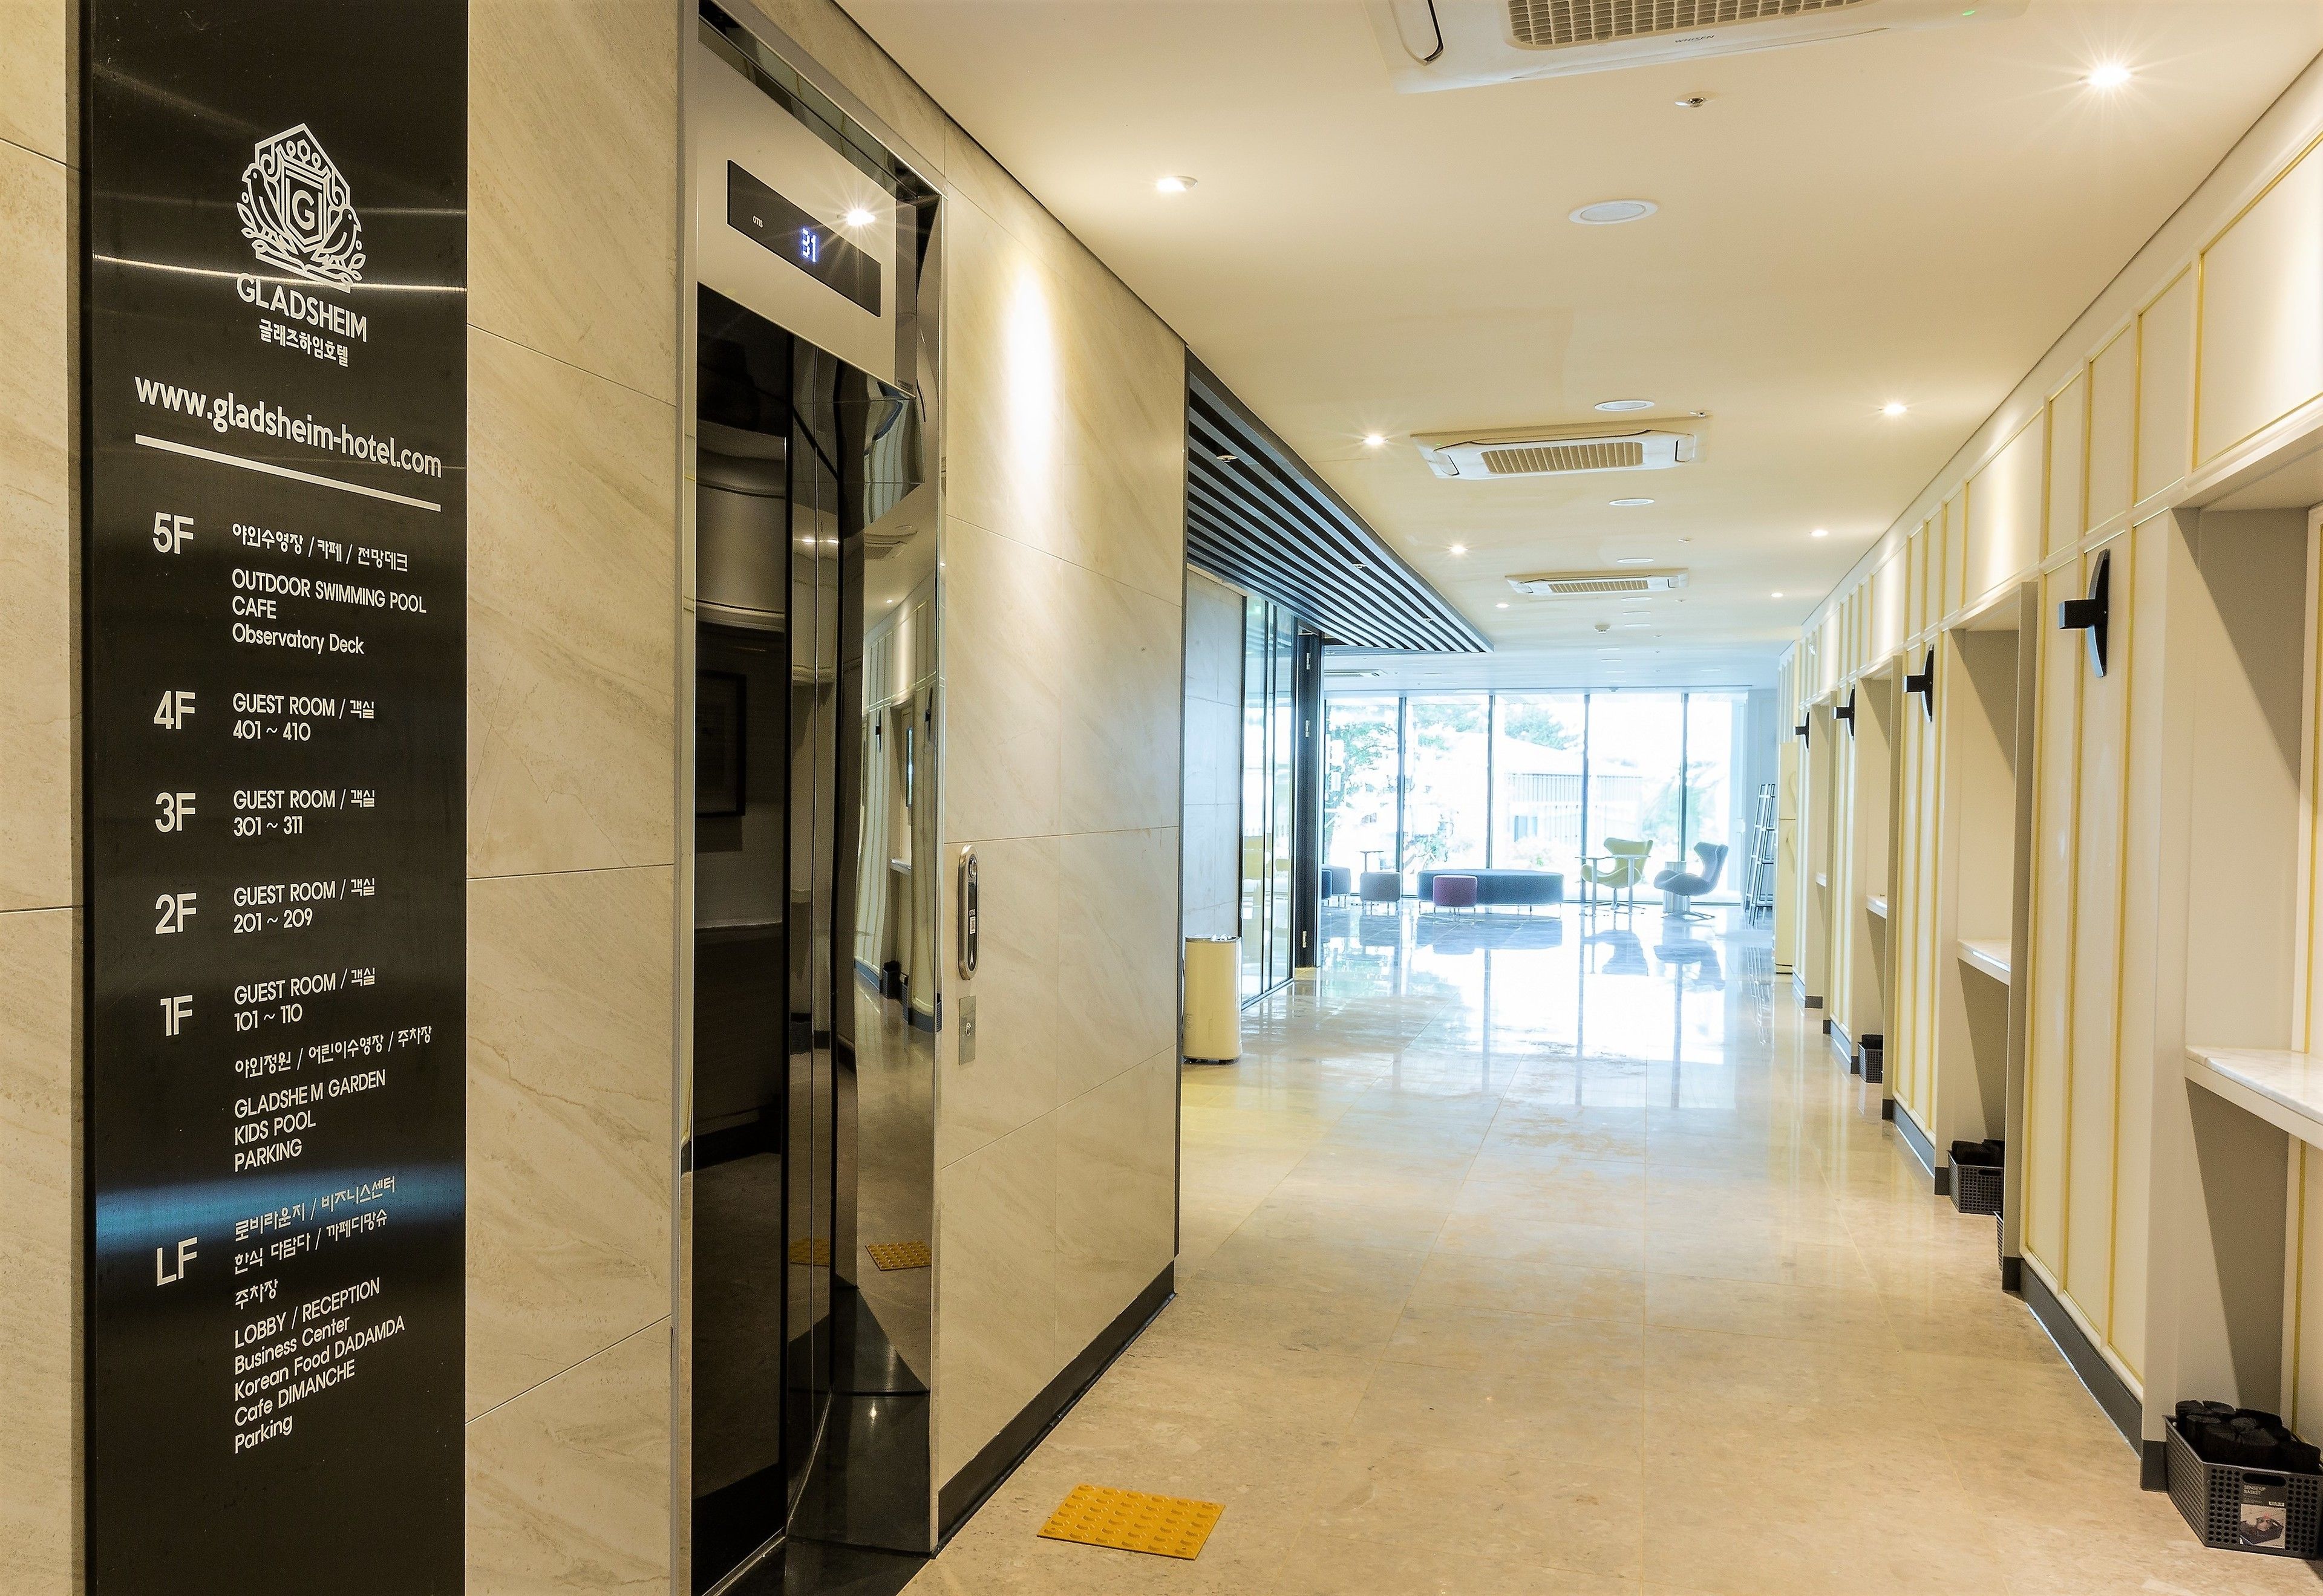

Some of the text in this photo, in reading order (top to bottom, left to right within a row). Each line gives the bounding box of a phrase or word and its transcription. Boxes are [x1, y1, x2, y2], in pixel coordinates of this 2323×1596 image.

[291, 190, 316, 232] G
[753, 215, 763, 228] OTIS
[237, 272, 367, 343] GLADSHEIM
[259, 318, 348, 368] 글래즈하임호텔
[134, 376, 442, 478] www.gladsheim-hotel.com
[152, 511, 194, 555] 5F
[232, 523, 304, 555] 야외수영장
[317, 539, 342, 562] 카페
[358, 547, 408, 572] 전망데크
[232, 568, 427, 614] OUTDOOR SWIMMING POOL
[232, 595, 276, 619] CAFE
[232, 622, 365, 655] Observatory Deck
[154, 690, 195, 729] 4F
[232, 692, 284, 714] GUEST
[289, 696, 335, 717] ROOM
[350, 700, 374, 719] 객실
[233, 720, 261, 740] 401
[283, 721, 311, 741] 410
[155, 792, 196, 833] 3F
[233, 789, 285, 810] GUEST
[290, 789, 336, 809] ROOM
[350, 789, 375, 808] 객실
[233, 816, 261, 837] 301
[283, 815, 302, 835] 311
[234, 884, 286, 907] GUEST
[290, 881, 336, 902] ROOM
[350, 878, 375, 897] 객실
[155, 893, 197, 934] 2F
[234, 912, 262, 934] 201
[283, 907, 313, 928] 209
[234, 980, 286, 1005] GUEST
[290, 972, 336, 997] ROOM
[351, 967, 375, 987] 객실
[160, 994, 193, 1037] 1F
[234, 1009, 258, 1032] 101
[280, 1003, 302, 1024] 110
[235, 1051, 291, 1079] 야외정원
[309, 1034, 384, 1064] 어린이수영장
[397, 1025, 432, 1048] 주차장
[328, 1069, 385, 1098] GARDEN
[235, 1110, 316, 1145] KIDS POOL
[235, 1138, 302, 1172] PARKING
[235, 1202, 305, 1242] 로비라운지
[235, 1248, 263, 1275] 한식
[270, 1233, 310, 1260] 다담다
[326, 1209, 387, 1242] 까페디망슈
[157, 1236, 198, 1286] LF
[235, 1278, 278, 1310] 주차장
[235, 1311, 287, 1349] LOBBY
[302, 1277, 380, 1323] RECEPTION
[235, 1316, 350, 1375] Business Center
[235, 1315, 405, 1402] Korean Food DADAMDA
[235, 1358, 355, 1426] Cafe DIMANCHE
[235, 1415, 293, 1454] Parking
